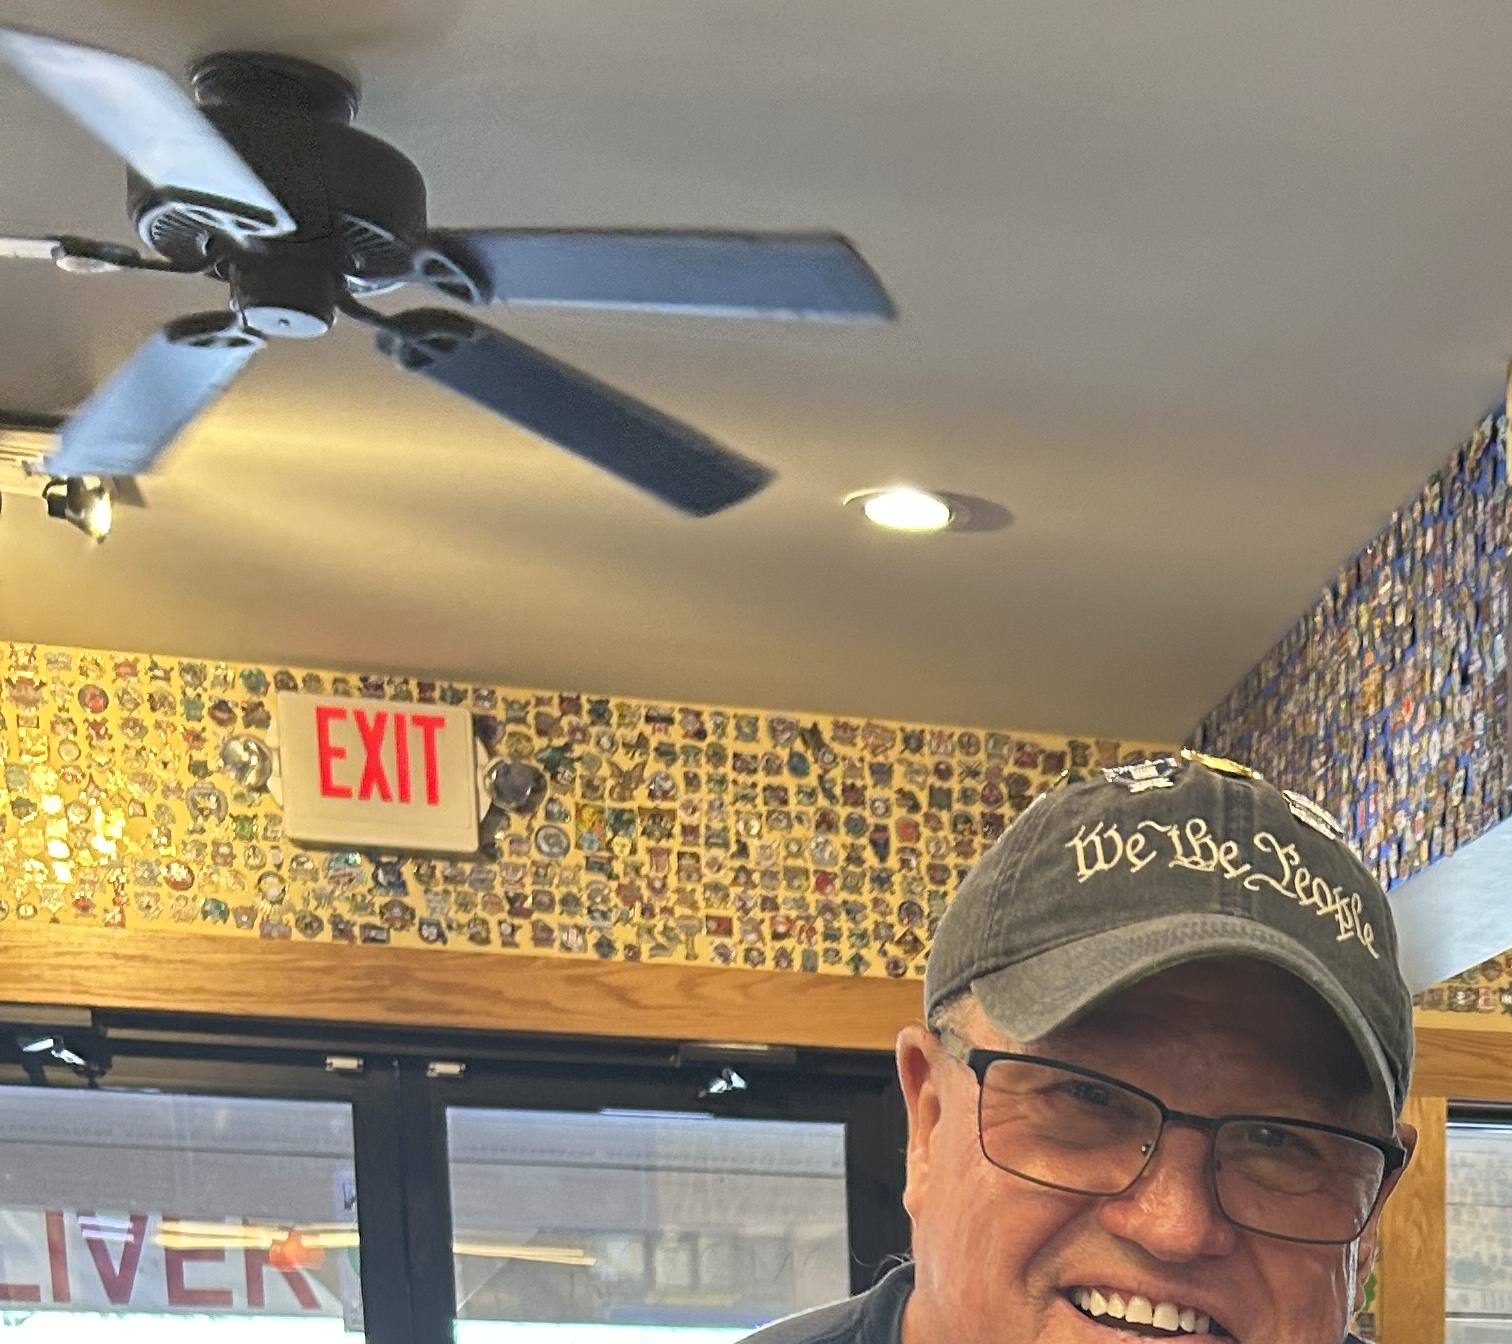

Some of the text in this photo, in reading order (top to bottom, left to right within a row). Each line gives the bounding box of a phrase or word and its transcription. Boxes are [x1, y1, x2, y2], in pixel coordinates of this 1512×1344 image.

[316, 706, 446, 805] EXIT
[1065, 822, 1158, 884] We
[1244, 832, 1379, 959] People
